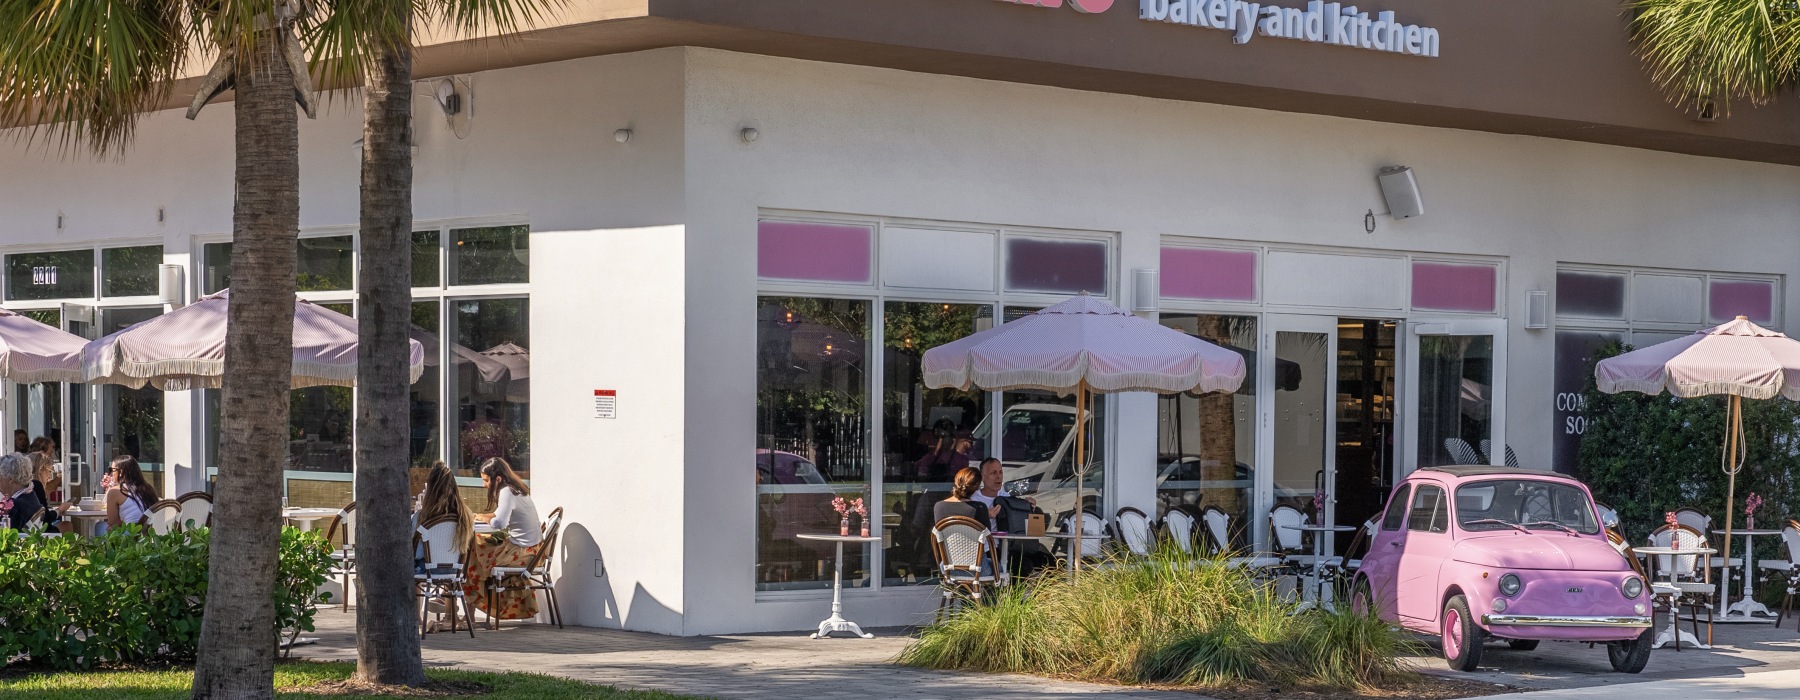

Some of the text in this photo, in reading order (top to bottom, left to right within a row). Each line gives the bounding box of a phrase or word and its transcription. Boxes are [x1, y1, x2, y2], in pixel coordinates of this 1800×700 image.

[1139, 0, 1440, 57] bakery and kitchen
[33, 266, 57, 284] 2211
